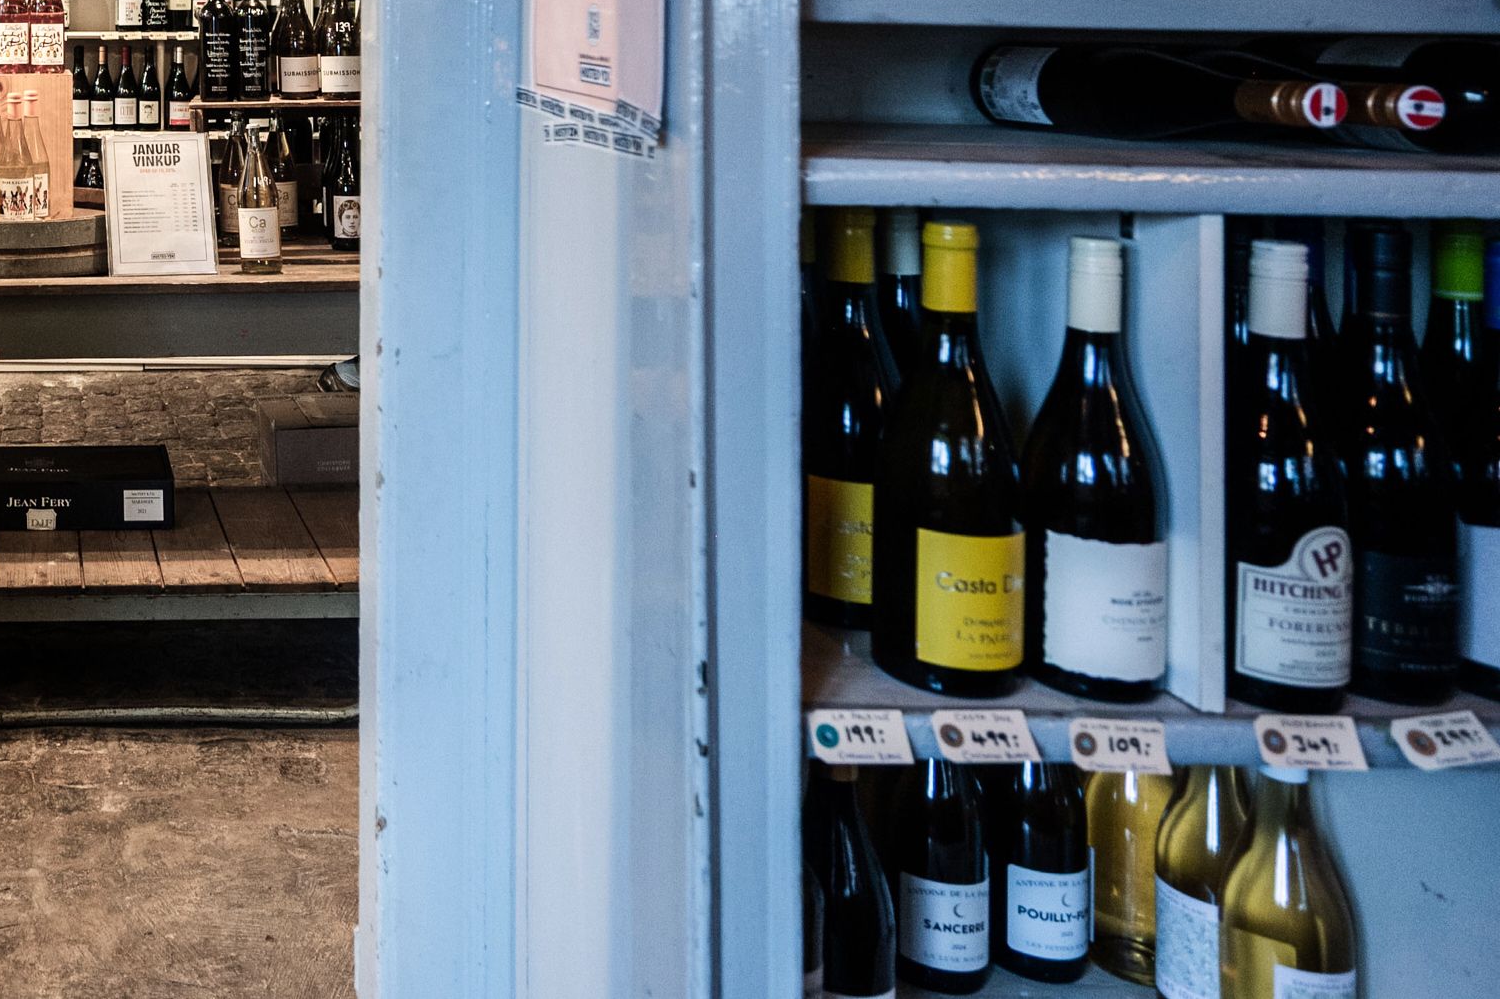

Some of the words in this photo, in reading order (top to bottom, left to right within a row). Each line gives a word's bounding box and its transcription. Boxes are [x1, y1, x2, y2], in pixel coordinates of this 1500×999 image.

[323, 68, 361, 77] SUBMISSION
[132, 143, 181, 155] JANUAR
[133, 155, 181, 167] VINKUP
[249, 216, 266, 228] Ca
[6, 497, 37, 508] JEAN
[40, 496, 72, 508] FERY
[1252, 576, 1343, 600] HITCHING
[923, 918, 986, 935] SANCERRE
